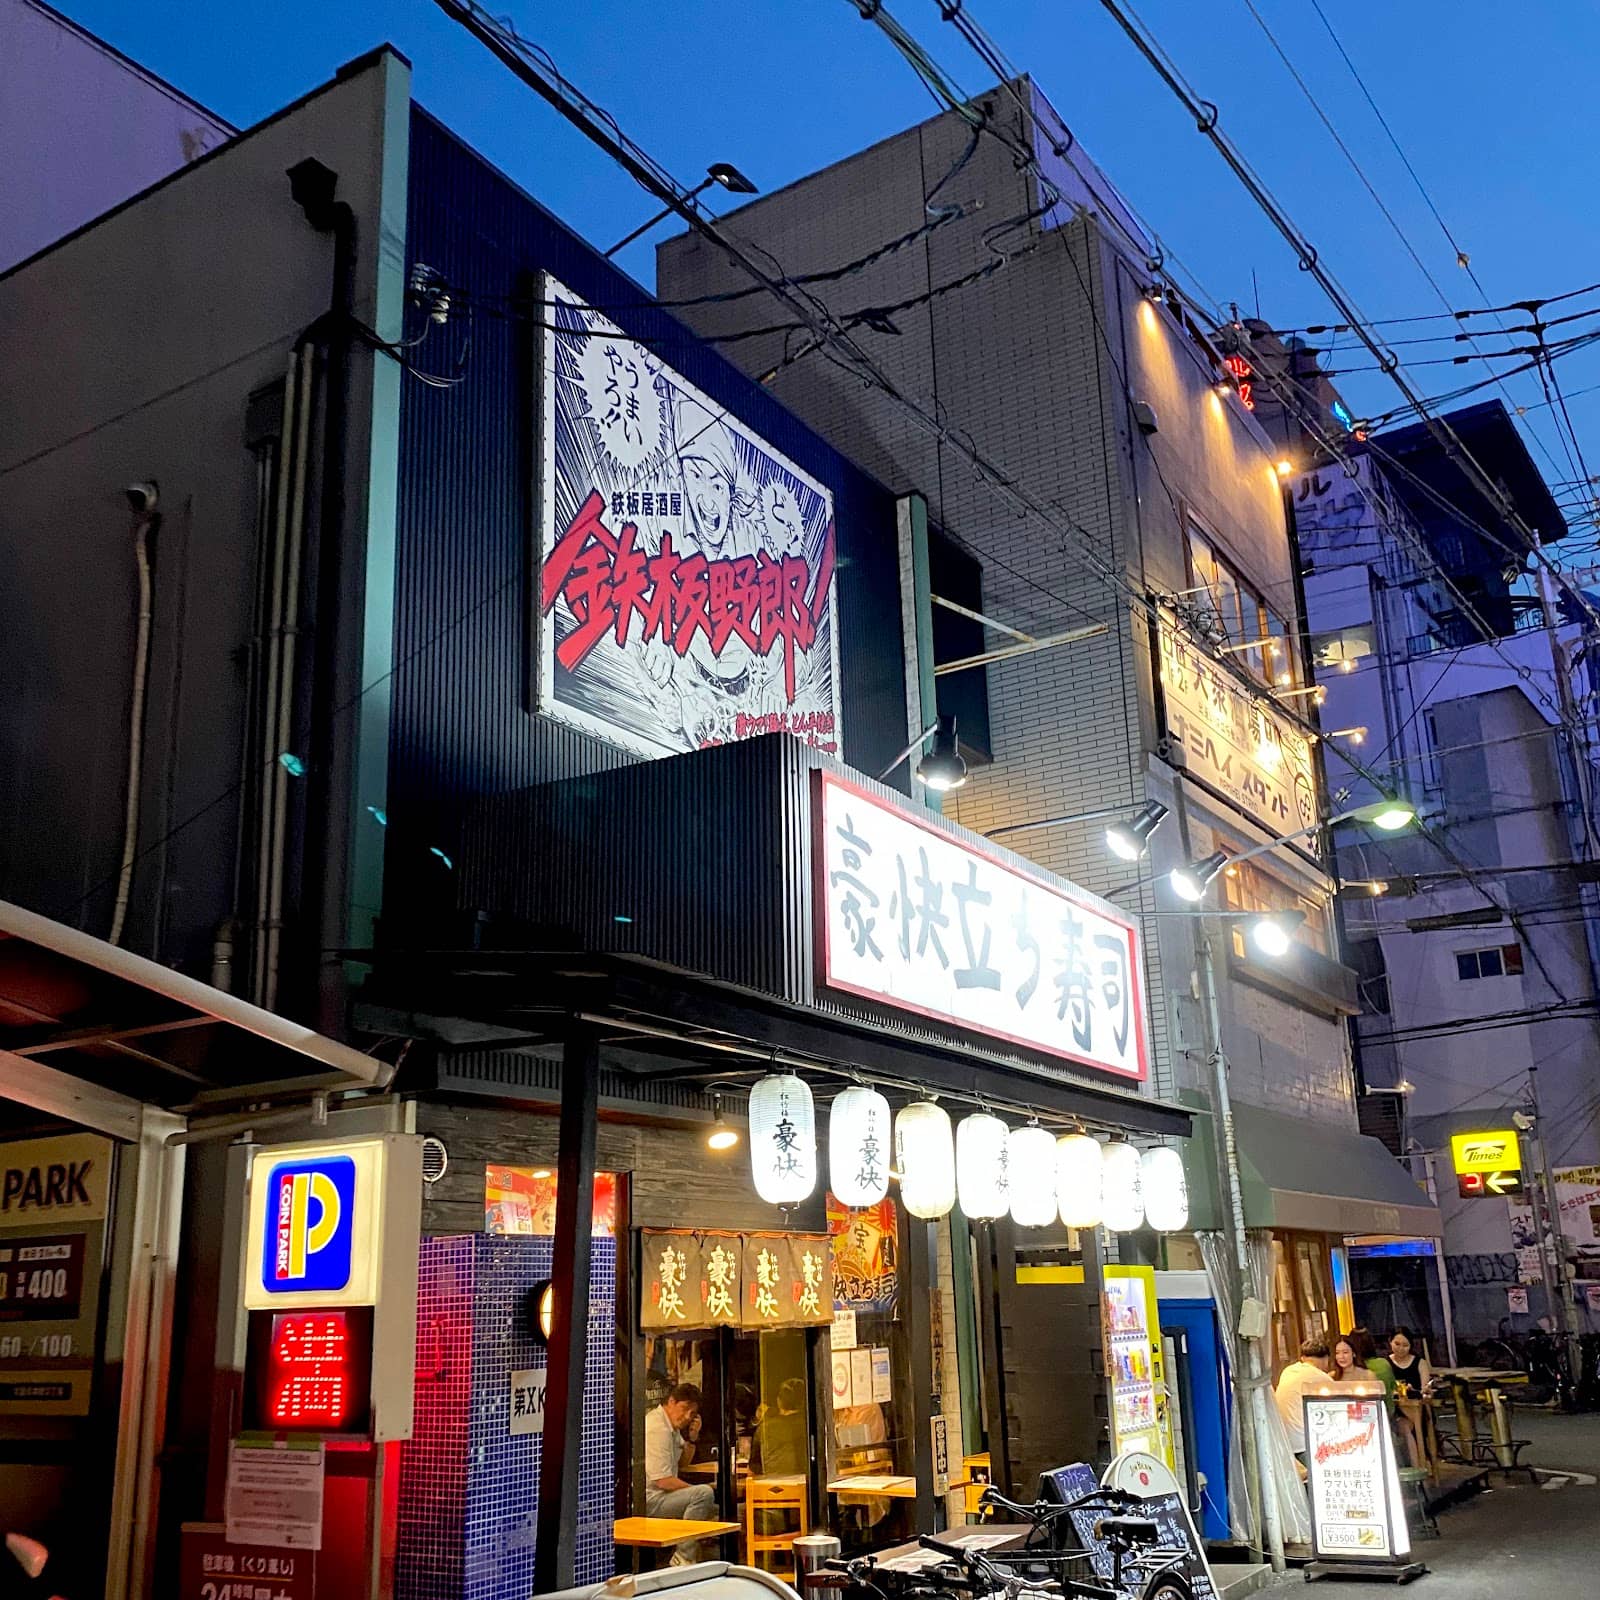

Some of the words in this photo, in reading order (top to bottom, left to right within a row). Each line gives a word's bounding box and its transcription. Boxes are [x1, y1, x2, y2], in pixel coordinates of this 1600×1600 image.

[610, 490, 683, 517] 鉄板居酒屋
[830, 812, 1129, 1057] 豪快立ち寿司
[772, 1117, 805, 1181] 豪快
[853, 1133, 883, 1193] 豪快
[1465, 1144, 1507, 1163] Times
[1, 1160, 94, 1212] PARK
[279, 1183, 292, 1225] COIN
[276, 1227, 291, 1273] PARK
[706, 1244, 734, 1318] 豪快
[658, 1245, 686, 1320] 豪快
[755, 1247, 779, 1318] 豪快
[798, 1250, 821, 1317] 豪快
